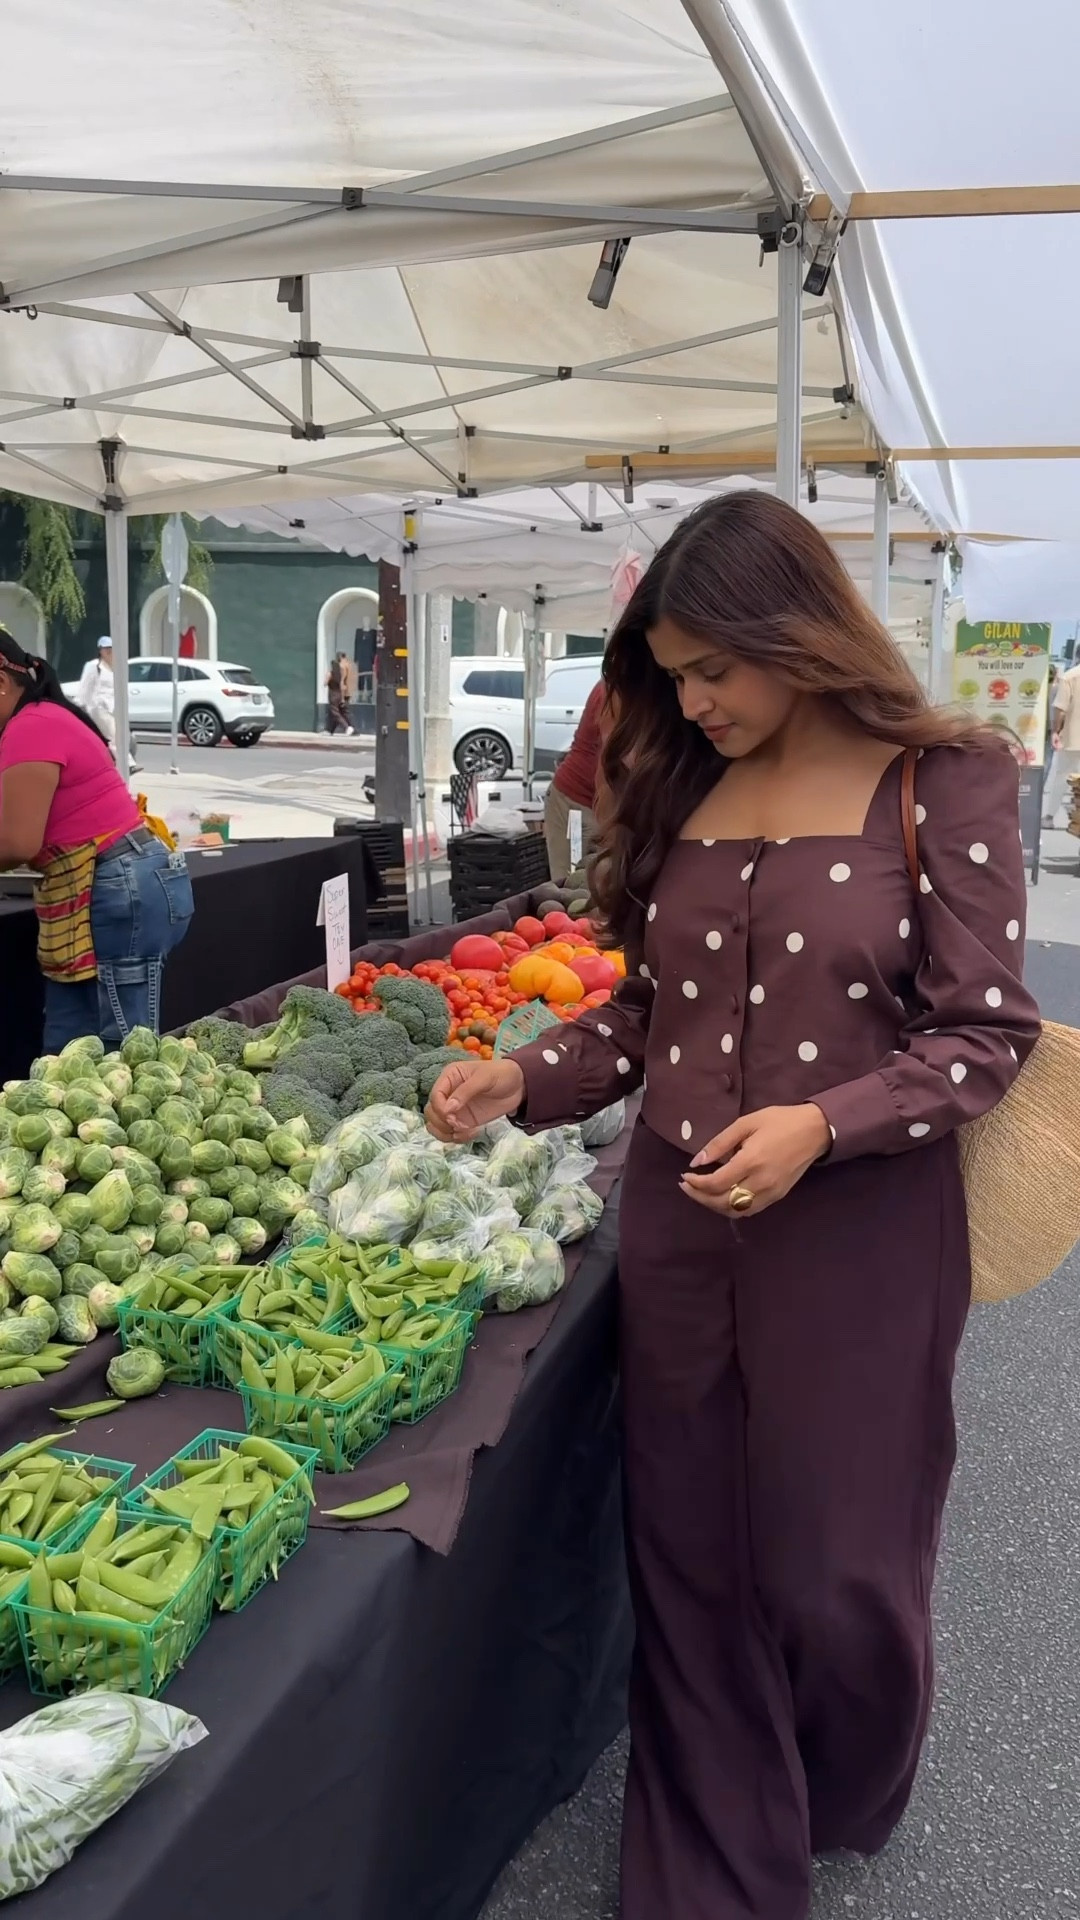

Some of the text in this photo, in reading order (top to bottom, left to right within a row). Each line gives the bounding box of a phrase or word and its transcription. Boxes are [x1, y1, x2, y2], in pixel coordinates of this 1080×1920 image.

[984, 622, 1021, 639] GILAN
[978, 659, 1025, 670] You will love our
